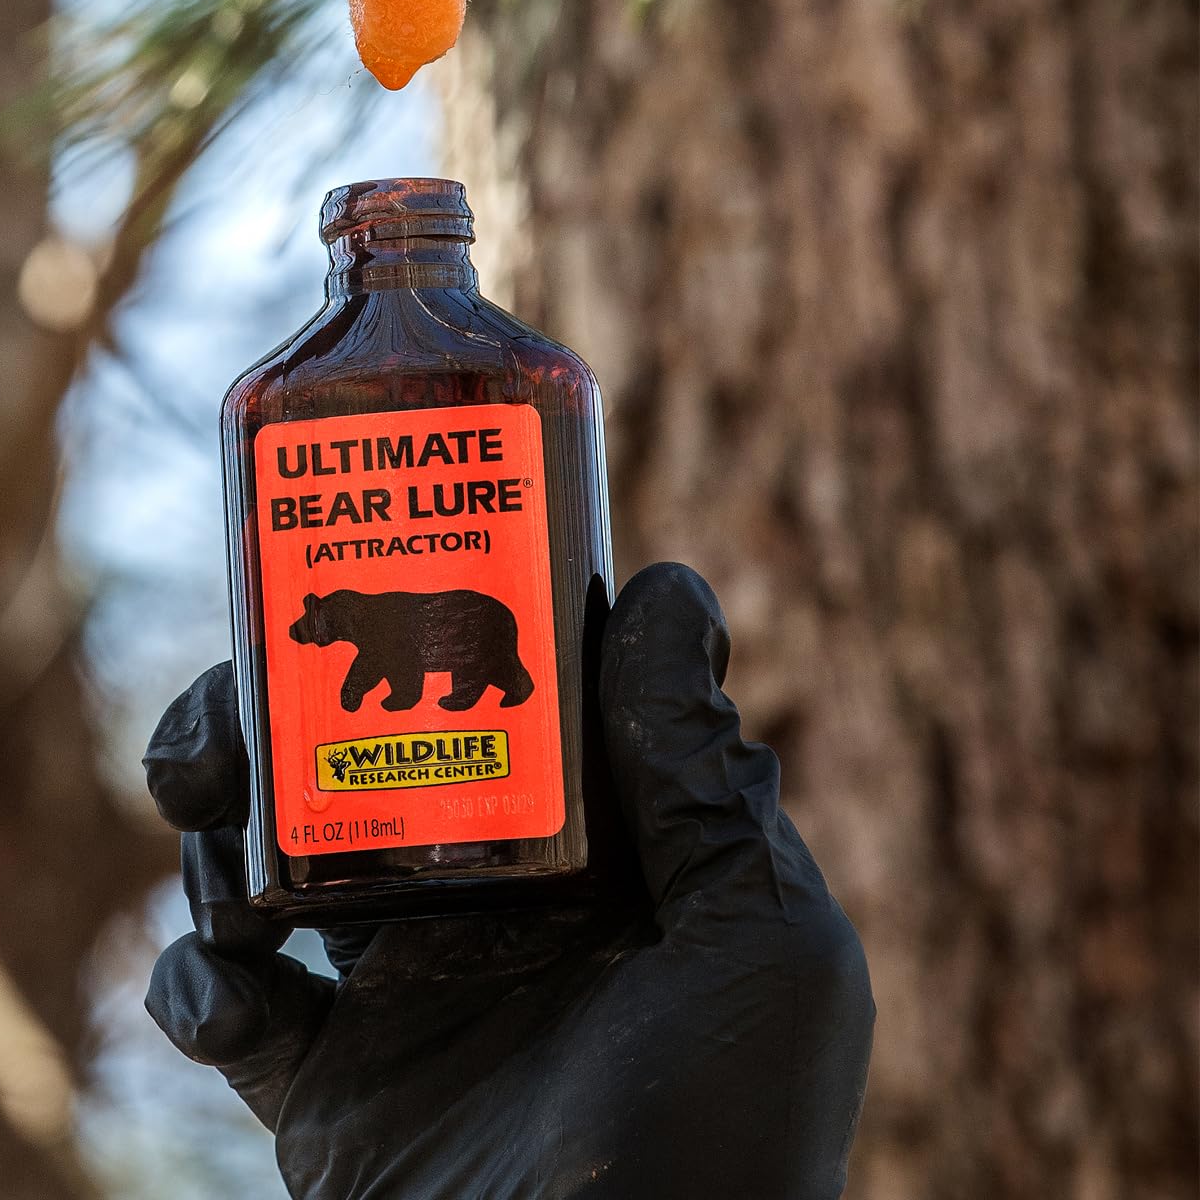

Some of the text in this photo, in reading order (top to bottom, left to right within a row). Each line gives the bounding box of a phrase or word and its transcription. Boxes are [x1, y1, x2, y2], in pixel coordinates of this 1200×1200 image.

[277, 428, 503, 479] ULTIMATE
[270, 487, 392, 532] BEAR
[305, 530, 491, 569] (ATTRACTOR)
[348, 734, 497, 768] WILDLIFE
[349, 768, 430, 786] RESEARCH
[290, 816, 405, 845] 4 FL OZ (118mL)
